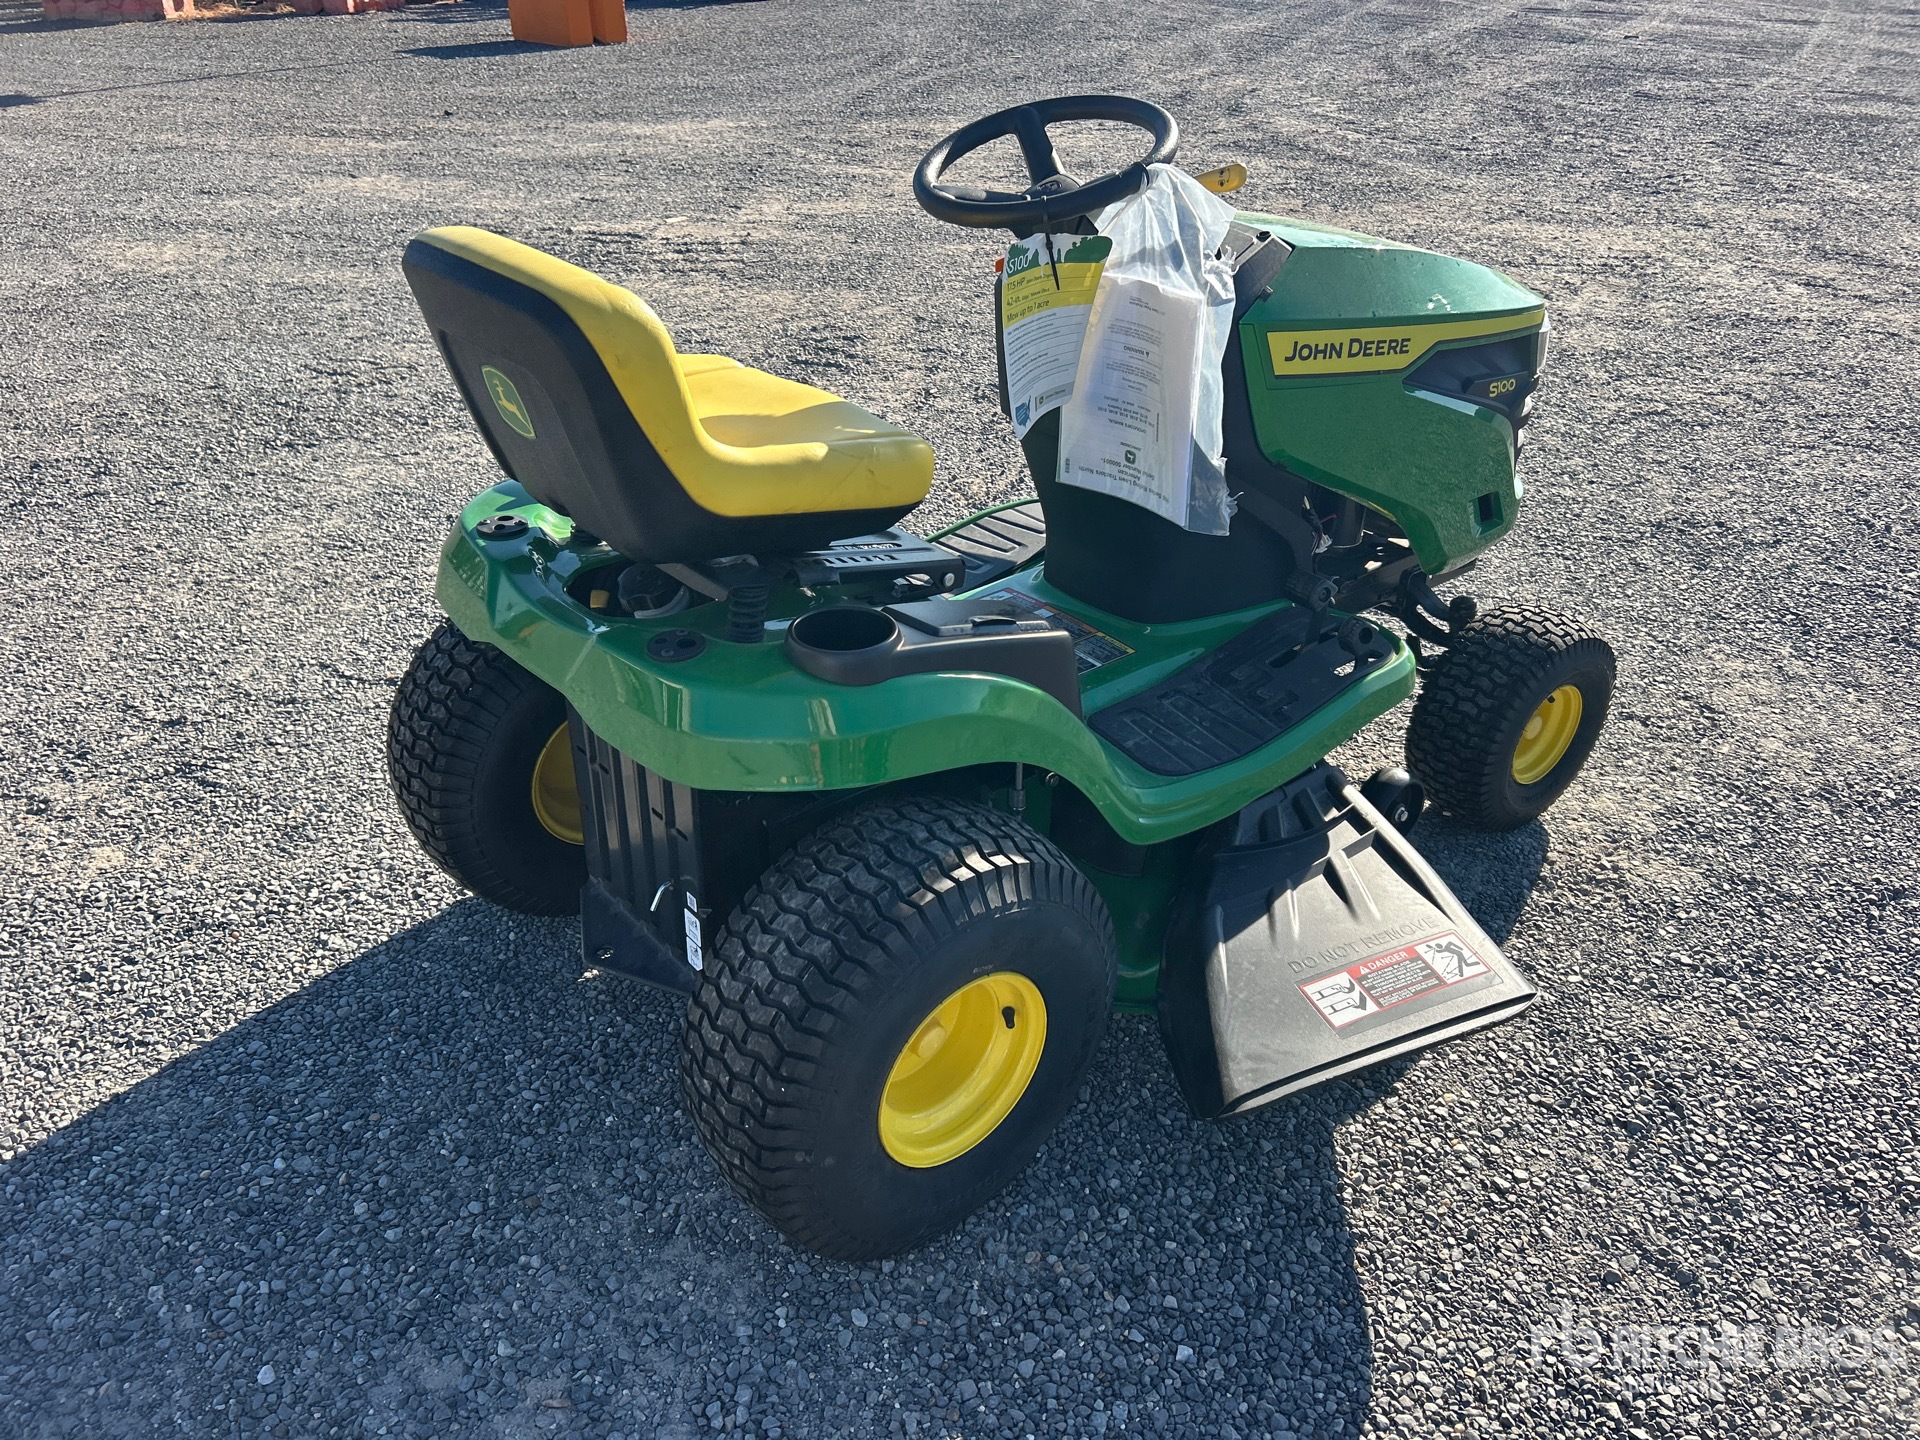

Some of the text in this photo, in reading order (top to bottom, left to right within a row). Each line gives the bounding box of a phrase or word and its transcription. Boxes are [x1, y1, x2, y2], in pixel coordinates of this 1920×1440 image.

[1009, 254, 1030, 274] S100
[1017, 277, 1026, 287] HP
[1007, 312, 1019, 322] Mow
[1019, 308, 1027, 317] up
[1027, 305, 1033, 313] to
[1037, 300, 1050, 309] acre
[1123, 345, 1145, 356] WARNING
[1284, 338, 1411, 362] JOHN DEERE
[1489, 379, 1516, 397] S100
[1078, 466, 1094, 474] North
[1123, 463, 1141, 474] Number
[1096, 470, 1117, 480] Tractors
[1117, 469, 1140, 481] American
[1118, 476, 1132, 485] Lawn
[1288, 916, 1440, 974] DO NOT REMOVE
[1367, 951, 1409, 970] DANGER
[1375, 978, 1397, 987] THROWN
